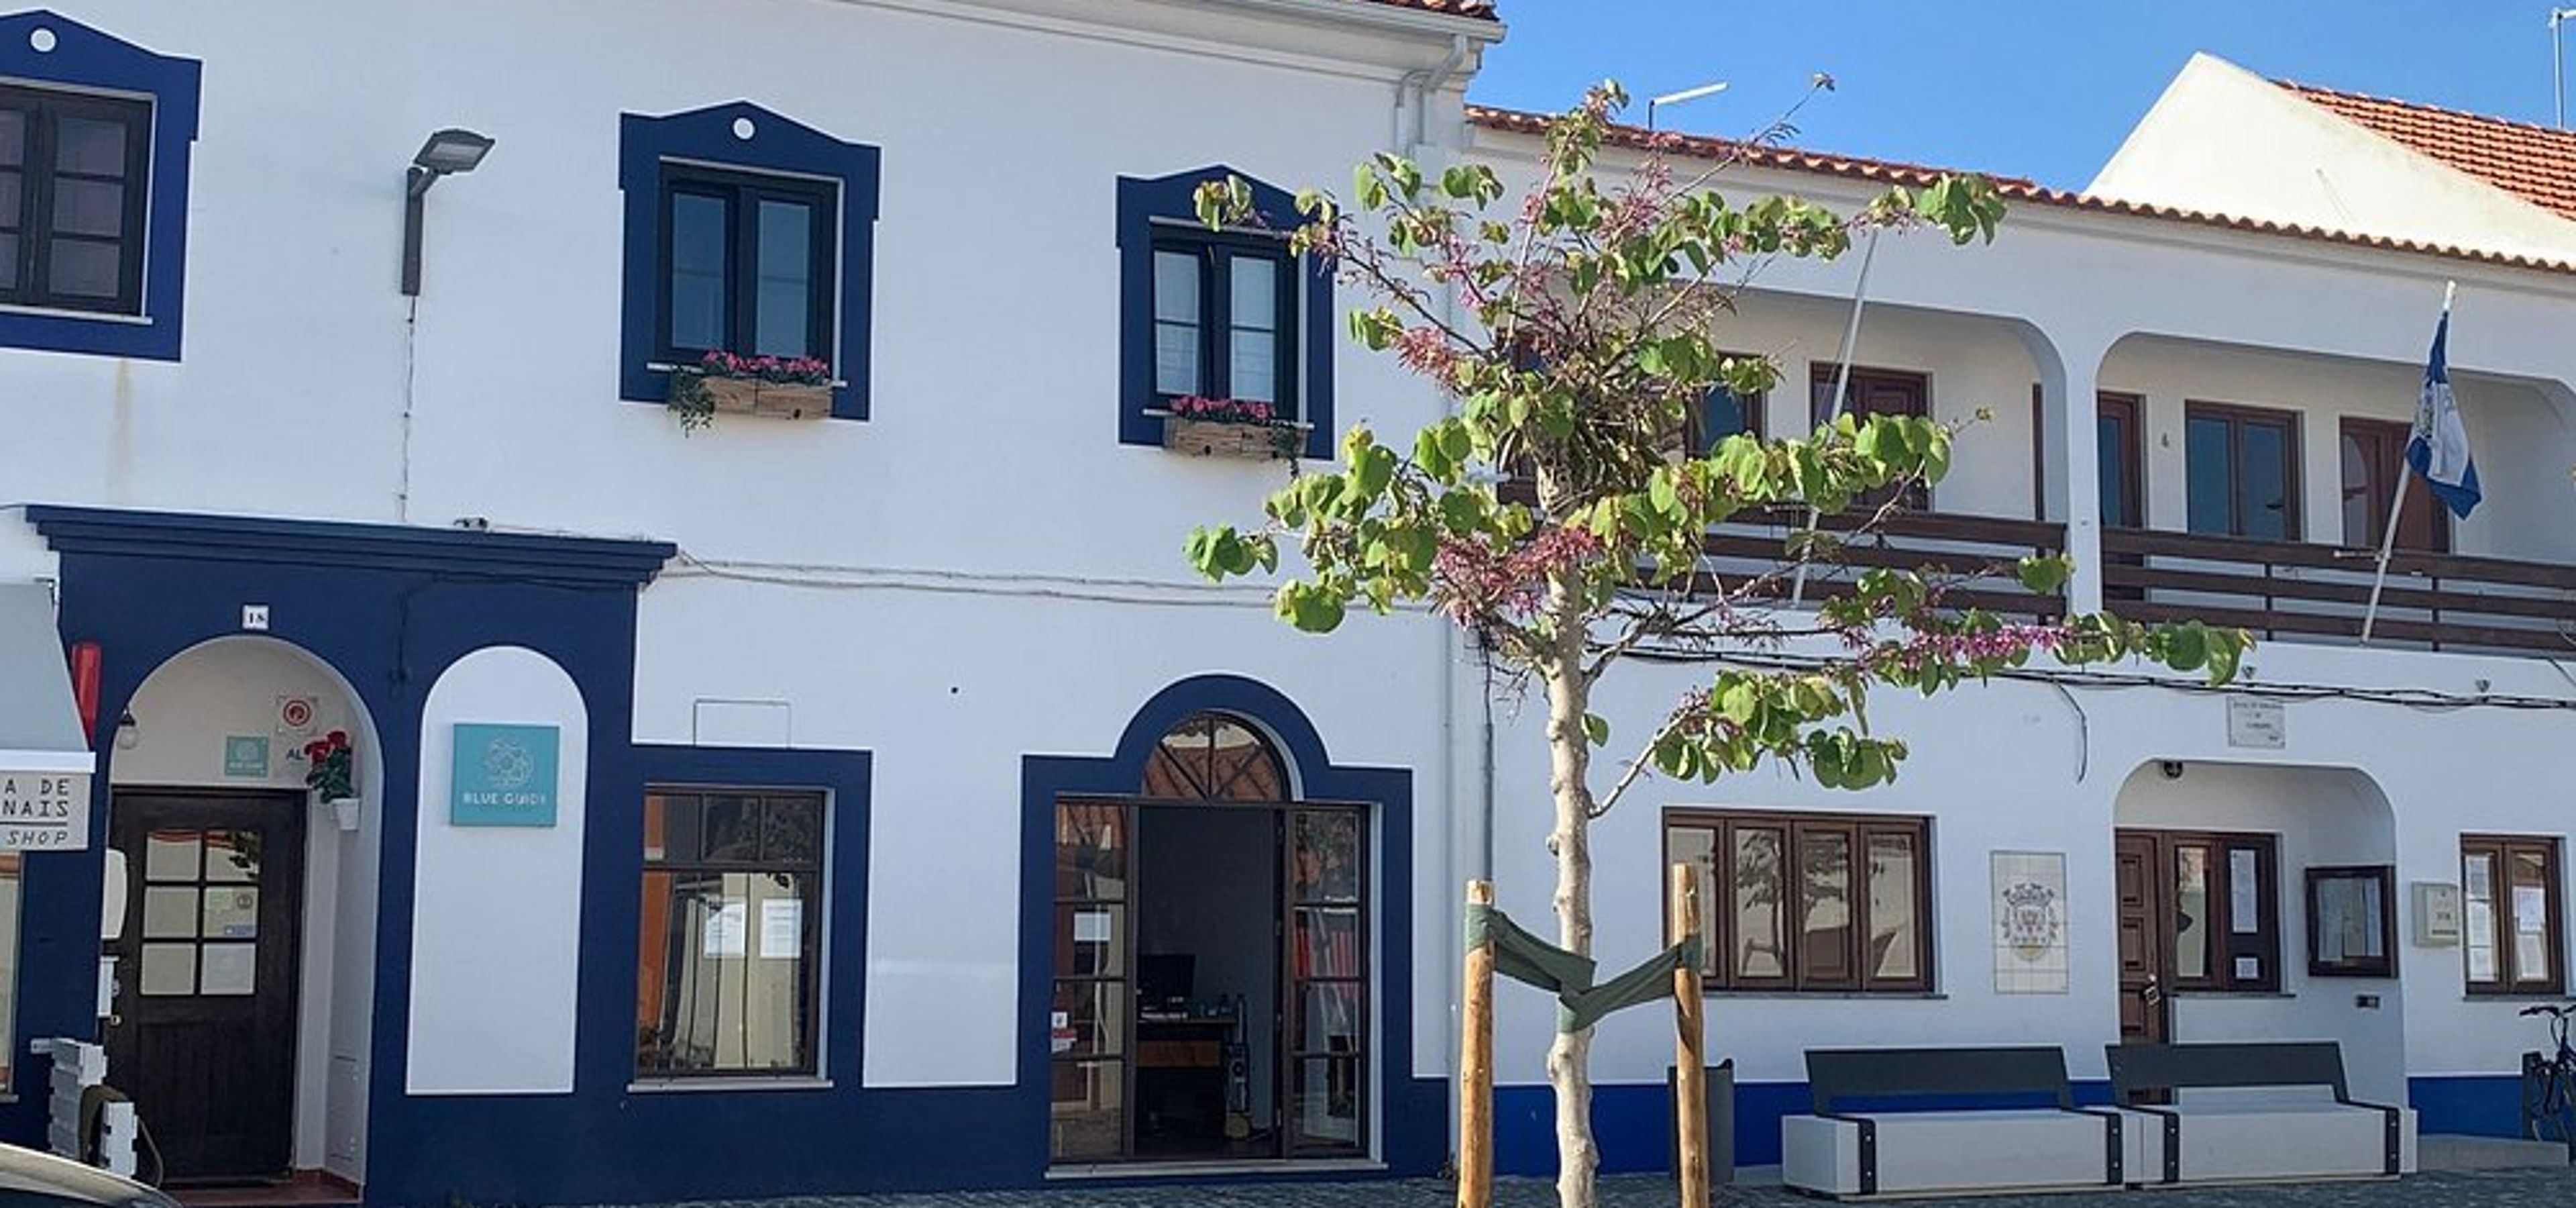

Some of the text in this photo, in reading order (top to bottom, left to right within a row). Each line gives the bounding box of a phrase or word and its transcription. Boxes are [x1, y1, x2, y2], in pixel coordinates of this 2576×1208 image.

[41, 778, 69, 795] DE
[464, 791, 498, 804] BLUE
[3, 800, 68, 817] NAIS
[8, 830, 68, 845] SHOP
